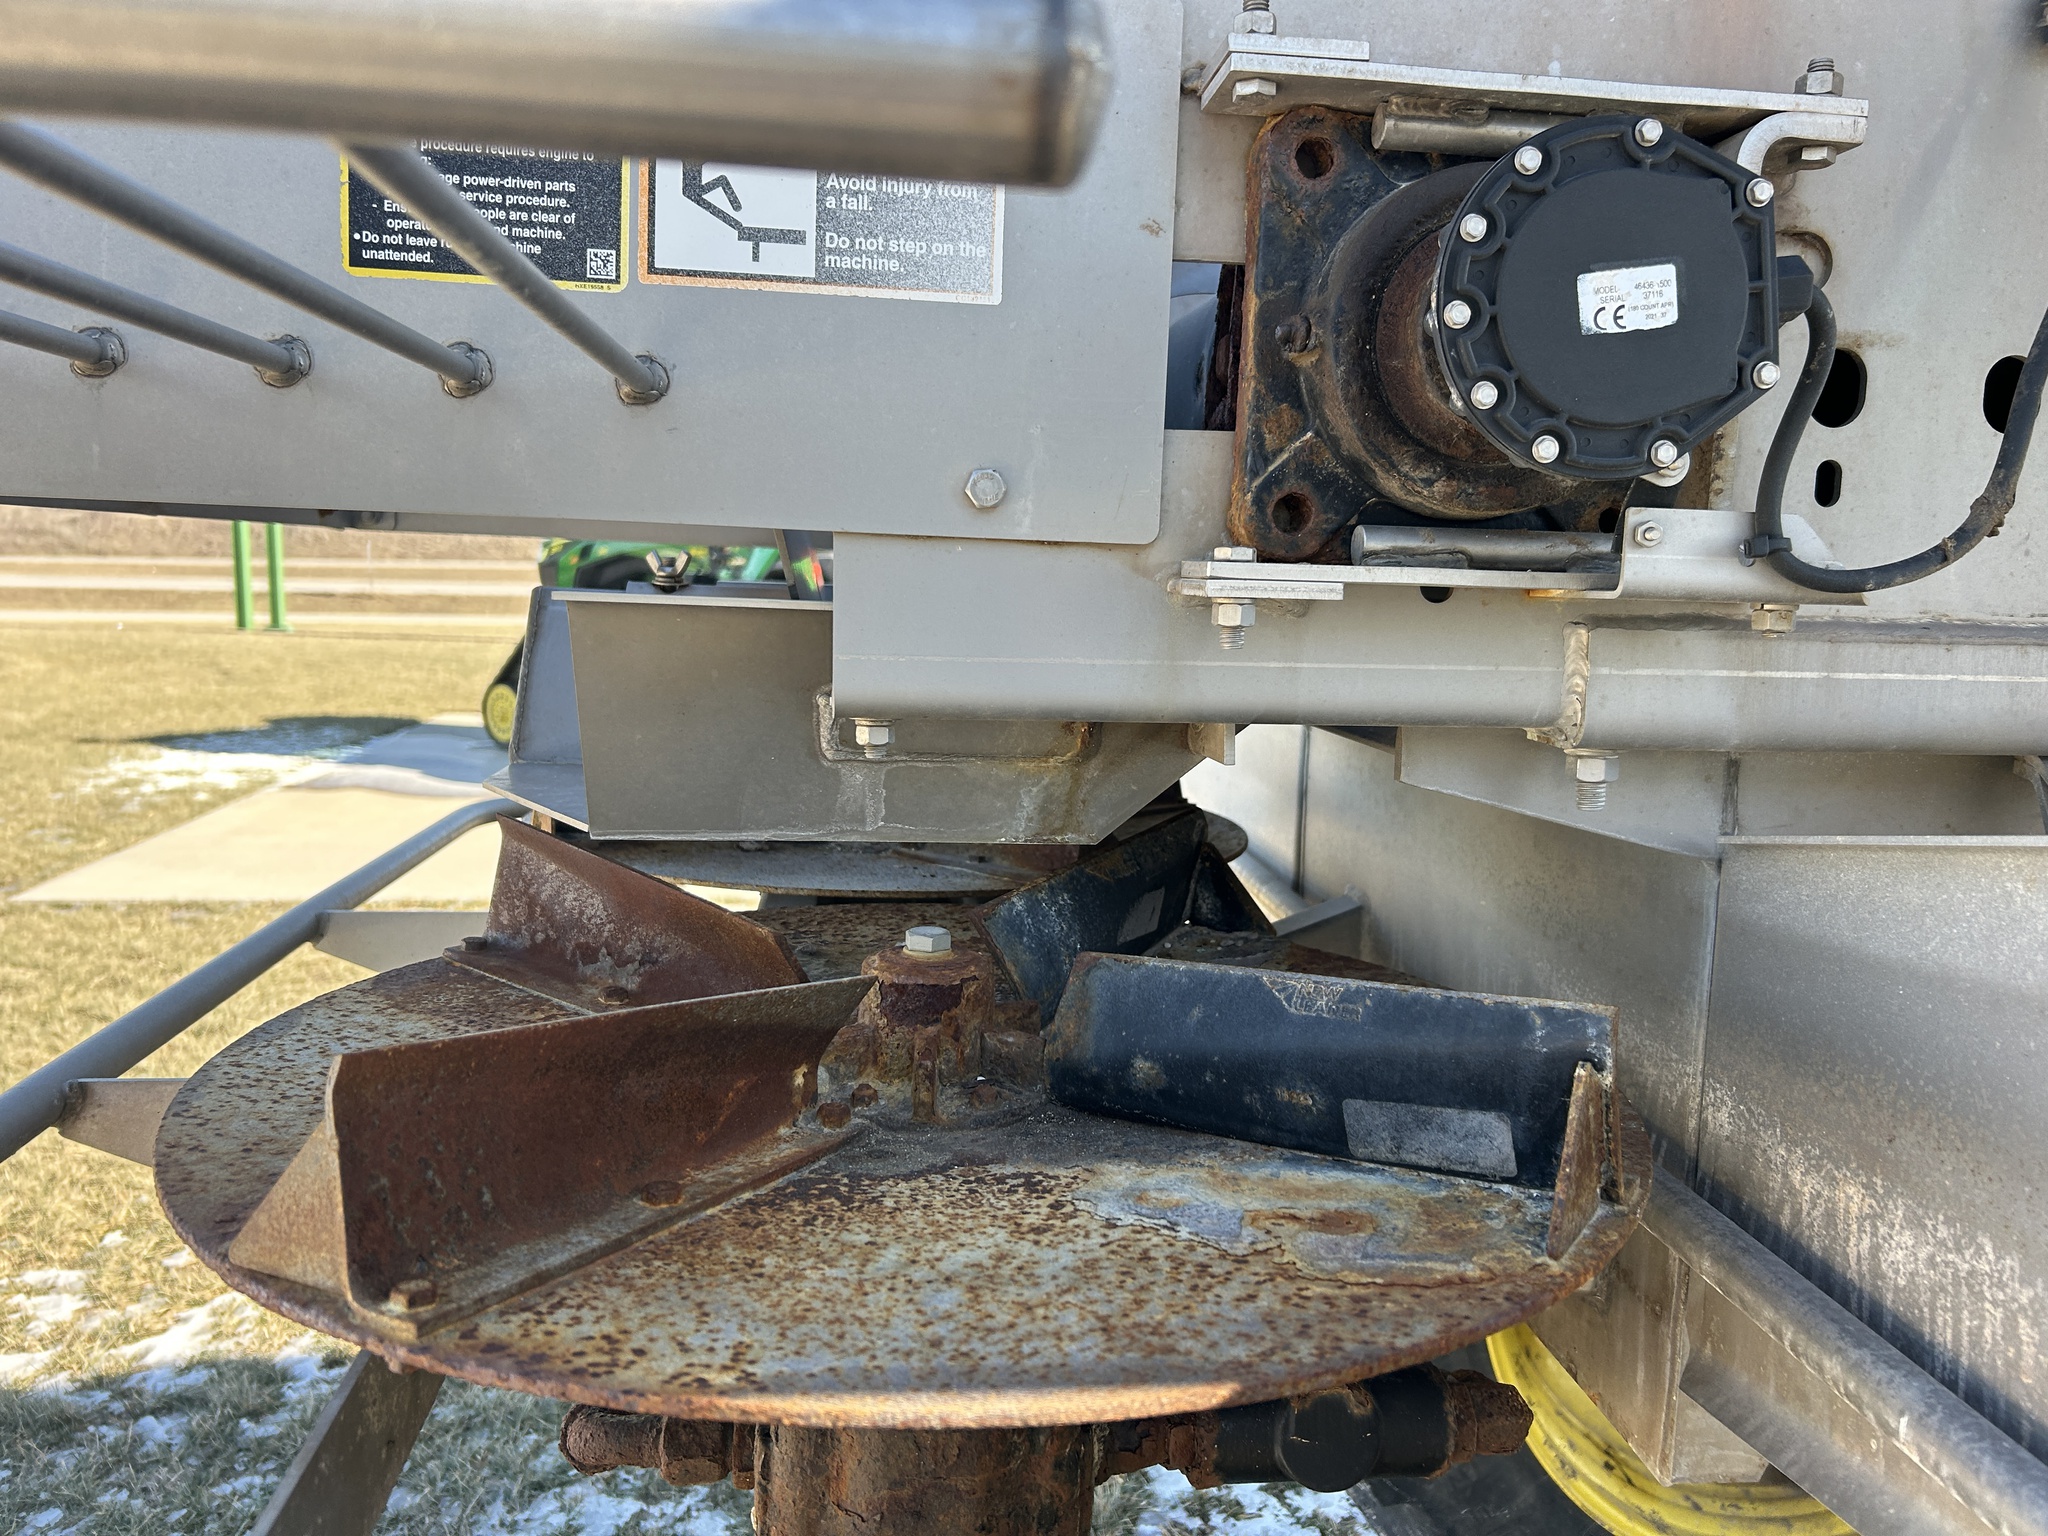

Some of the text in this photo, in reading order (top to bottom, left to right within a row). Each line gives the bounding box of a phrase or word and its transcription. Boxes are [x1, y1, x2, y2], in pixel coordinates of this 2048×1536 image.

[420, 139, 483, 153] procedure
[485, 144, 536, 157] requires
[538, 150, 580, 161] engine
[582, 152, 595, 161] to
[463, 174, 542, 190] power-driven
[544, 181, 576, 193] parts
[826, 173, 978, 198] Avoid injury from
[459, 190, 571, 208] service procedure.
[825, 194, 874, 211] a fall.
[383, 200, 407, 213] Ens
[508, 211, 529, 220] are
[531, 211, 561, 223] clear
[563, 213, 577, 224] of
[362, 231, 380, 243] Do
[382, 233, 403, 245] not
[405, 234, 438, 248] leave
[511, 227, 567, 240] machine.
[825, 232, 988, 258] Do not step on the
[362, 248, 434, 263] unattended.
[824, 254, 905, 272] machine.
[1600, 295, 1626, 304] SERIAL
[1640, 303, 1659, 311] COUNT
